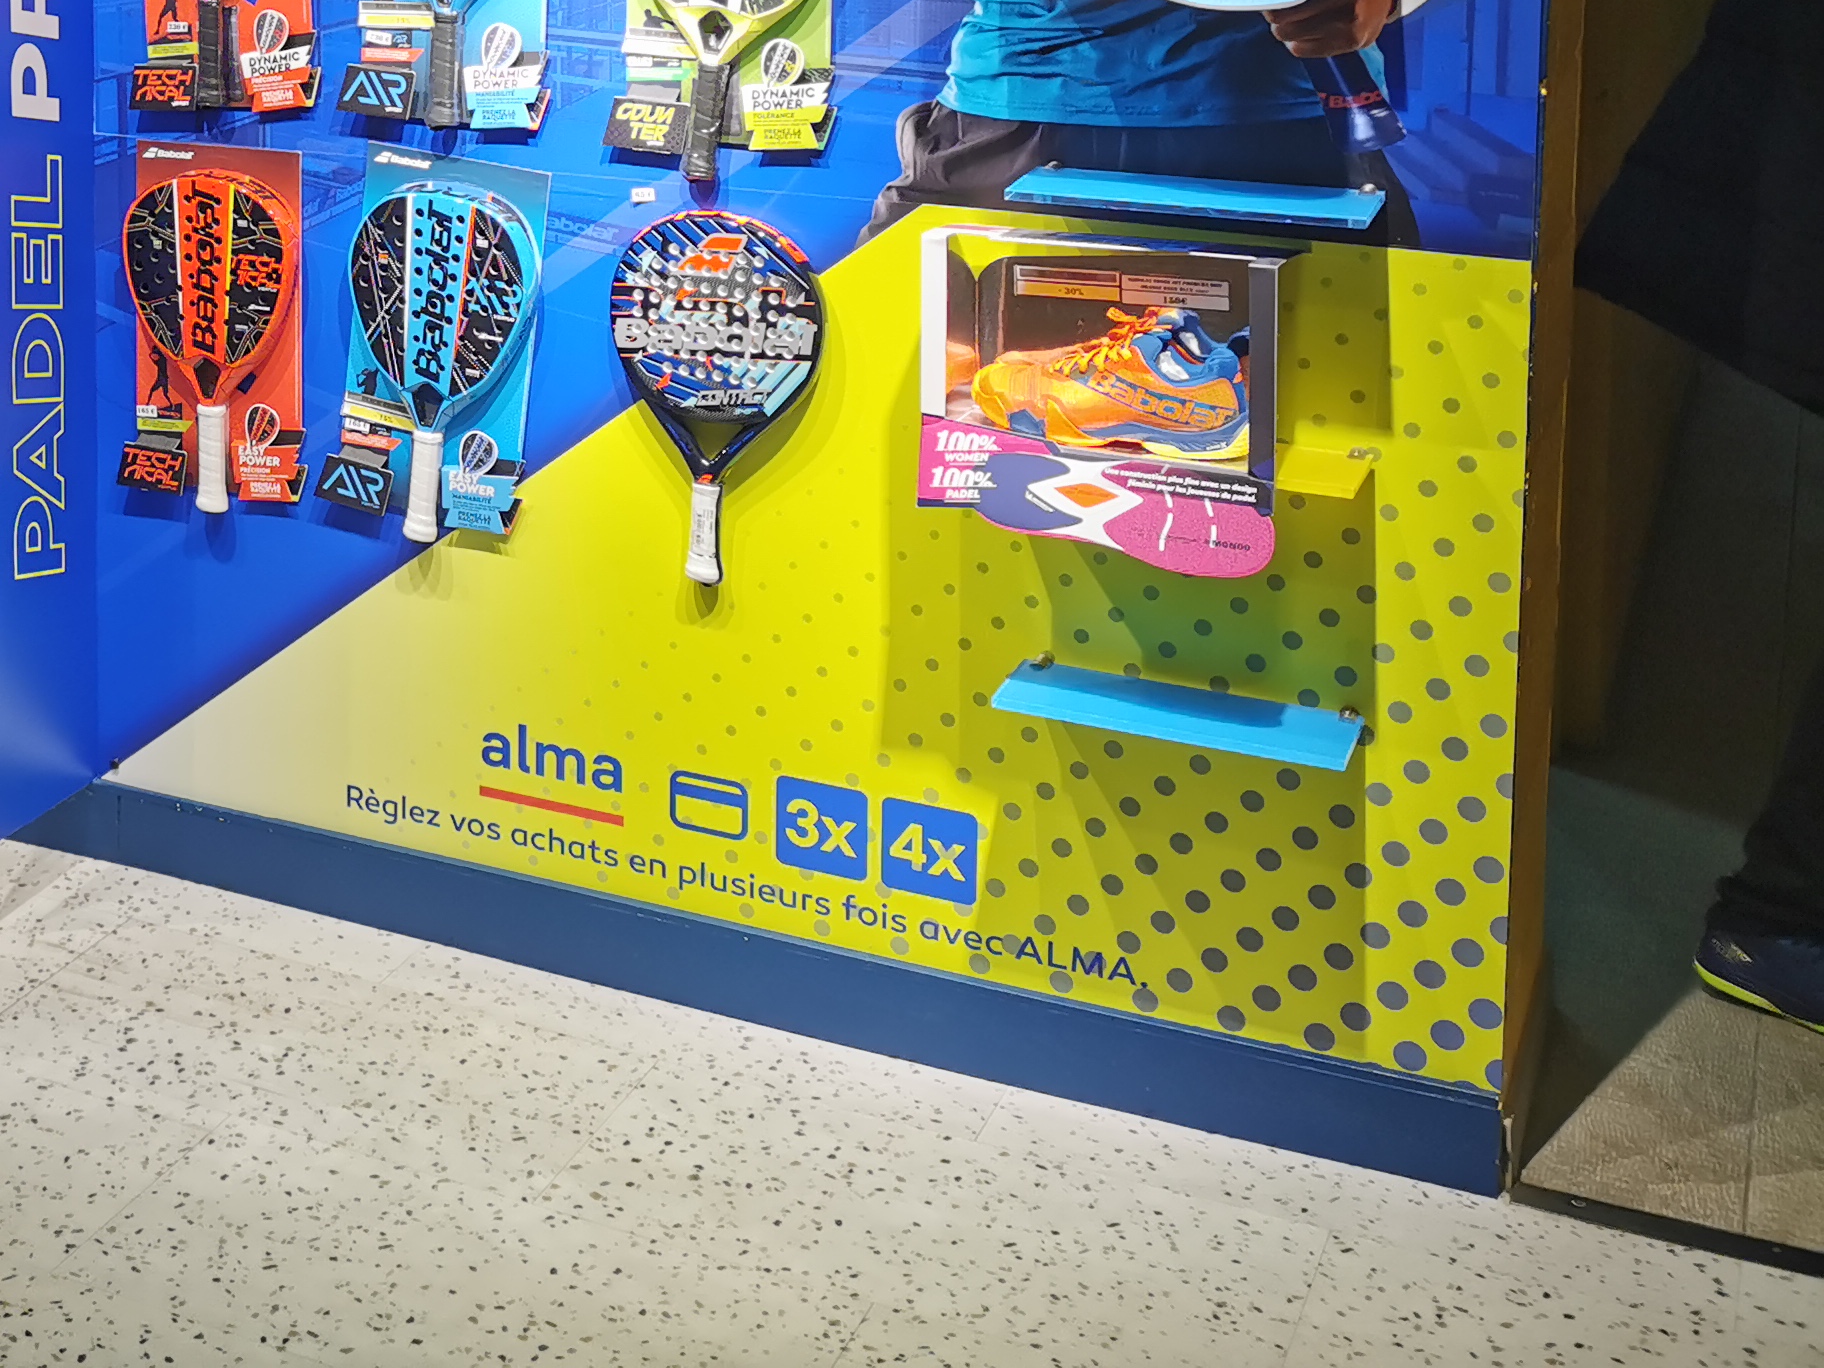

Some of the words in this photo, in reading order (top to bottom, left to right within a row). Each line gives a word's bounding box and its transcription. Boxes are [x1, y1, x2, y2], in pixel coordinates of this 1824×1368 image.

[249, 51, 300, 67] DYNAMIC
[133, 69, 193, 86] TECH
[251, 64, 291, 77] POWER
[473, 69, 529, 79] DYNAMIC
[343, 70, 407, 108] AIR
[474, 80, 518, 89] POWER
[752, 88, 815, 100] DYNAMIC
[753, 100, 803, 111] POWER
[629, 122, 670, 141] TER
[390, 155, 432, 169] Babolat
[191, 179, 218, 355] Babolat
[415, 199, 454, 385] Babolat
[1064, 287, 1084, 296] 30%
[614, 316, 818, 355] Babolat
[10, 154, 66, 580] PADEL
[696, 389, 773, 407] CONTACT
[1087, 370, 1238, 429] Babolat
[934, 430, 1002, 451] 100%
[124, 447, 182, 471] TECH
[238, 447, 265, 456] EASY
[944, 452, 990, 462] WOMEN
[239, 456, 280, 466] POWER
[322, 463, 384, 505] AIR
[449, 471, 480, 483] EASY
[929, 466, 997, 488] 100%
[1120, 470, 1167, 482] construction
[1231, 483, 1258, 494] design
[449, 482, 495, 497] POWER
[945, 489, 980, 499] PADEL
[480, 723, 624, 794] alma
[783, 797, 859, 859] 3x
[888, 822, 968, 883] 4x
[345, 784, 442, 829] Règlez
[449, 808, 501, 842] vos
[510, 821, 620, 870] achats
[629, 851, 668, 881] en
[678, 860, 833, 918] plusieurs
[841, 893, 908, 935] fois
[919, 917, 1004, 957] avec
[1014, 932, 1150, 990] ALMA.
